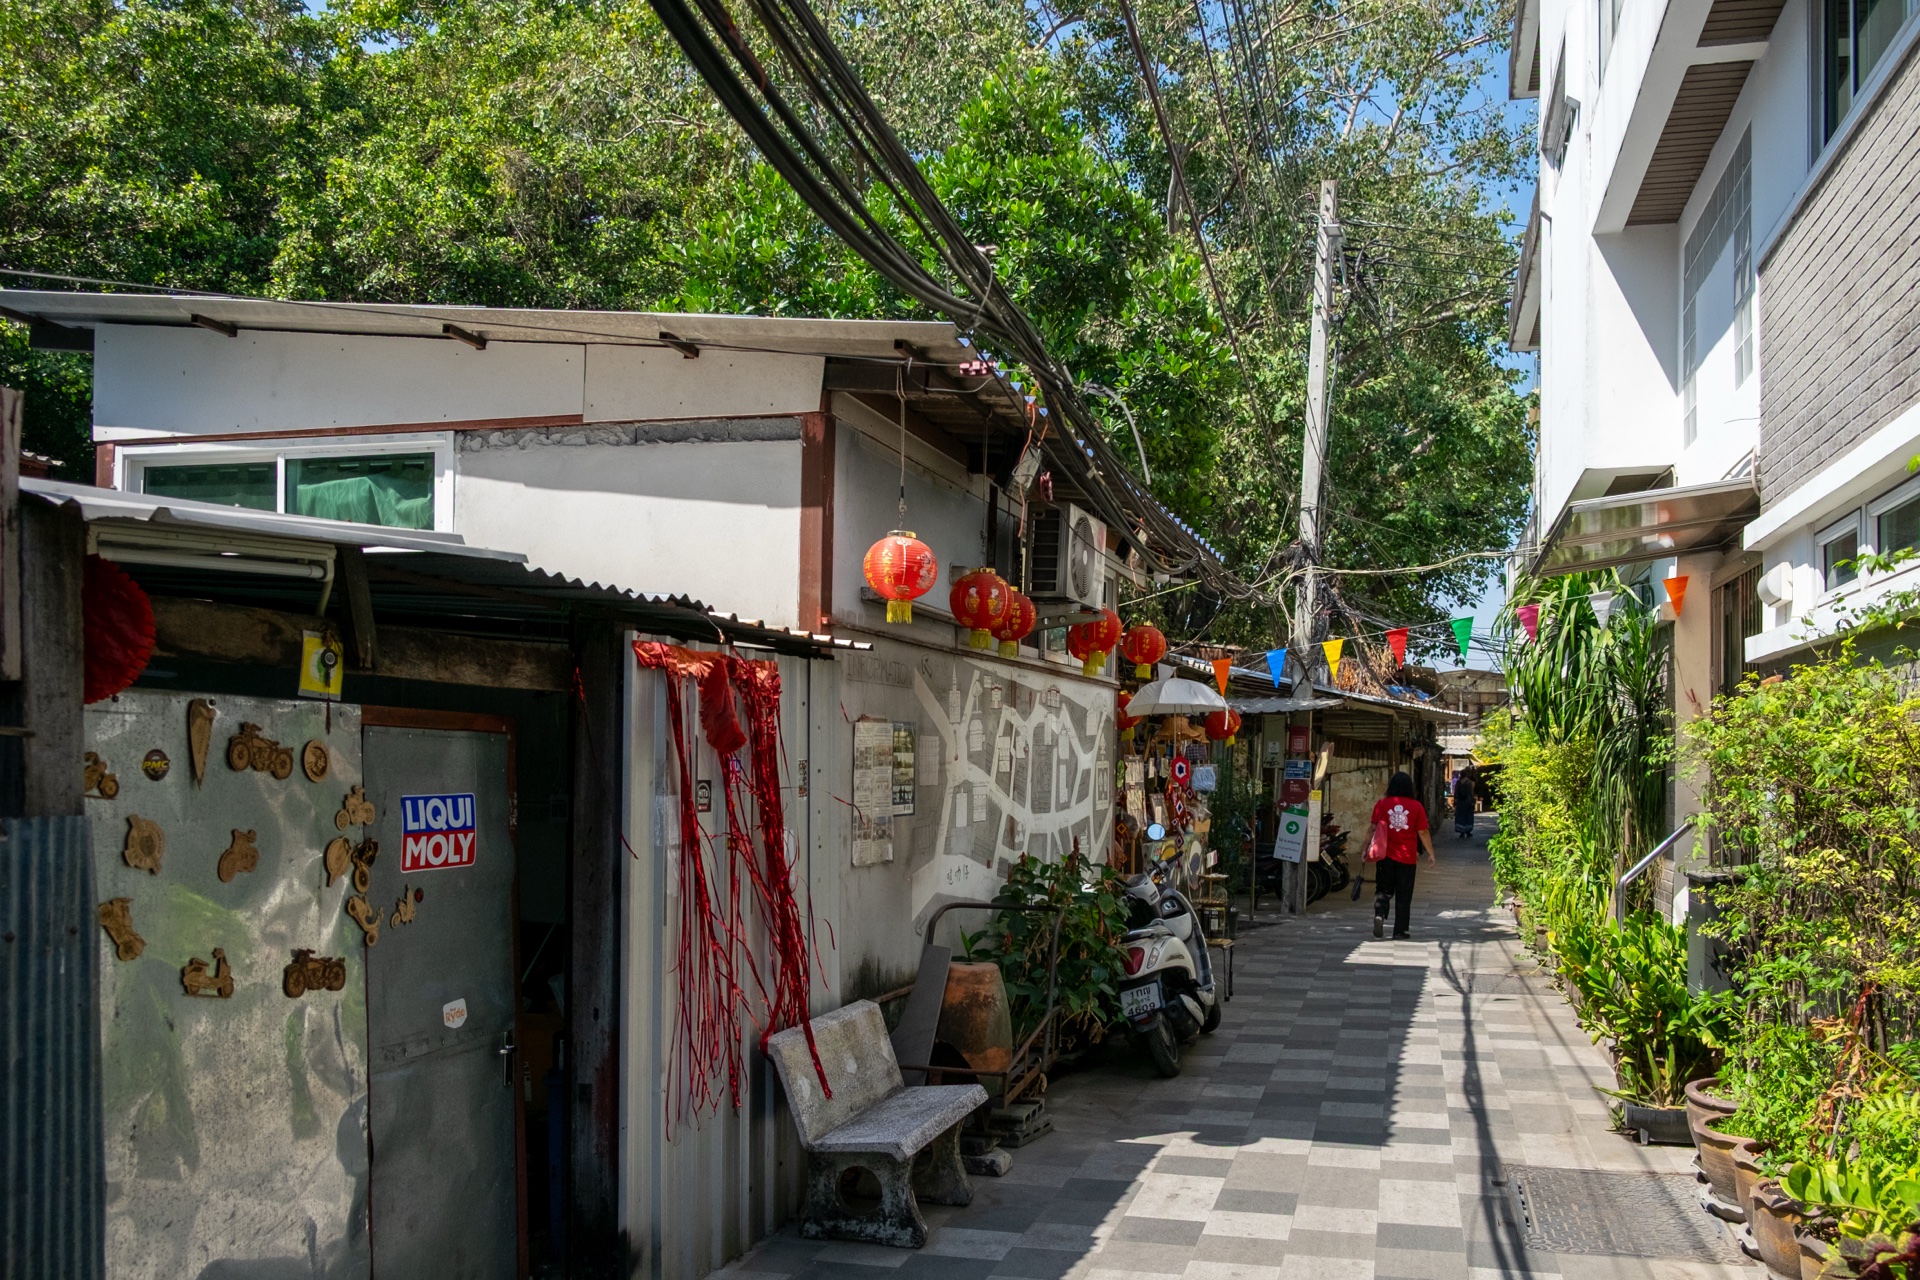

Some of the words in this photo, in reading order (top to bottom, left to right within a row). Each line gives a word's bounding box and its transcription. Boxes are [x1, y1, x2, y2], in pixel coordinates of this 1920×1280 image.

[143, 760, 169, 770] PMC
[405, 797, 473, 831] LIQUI
[405, 832, 475, 868] MOLY
[445, 1008, 465, 1023] Ryde
[1128, 1001, 1156, 1016] 4609
